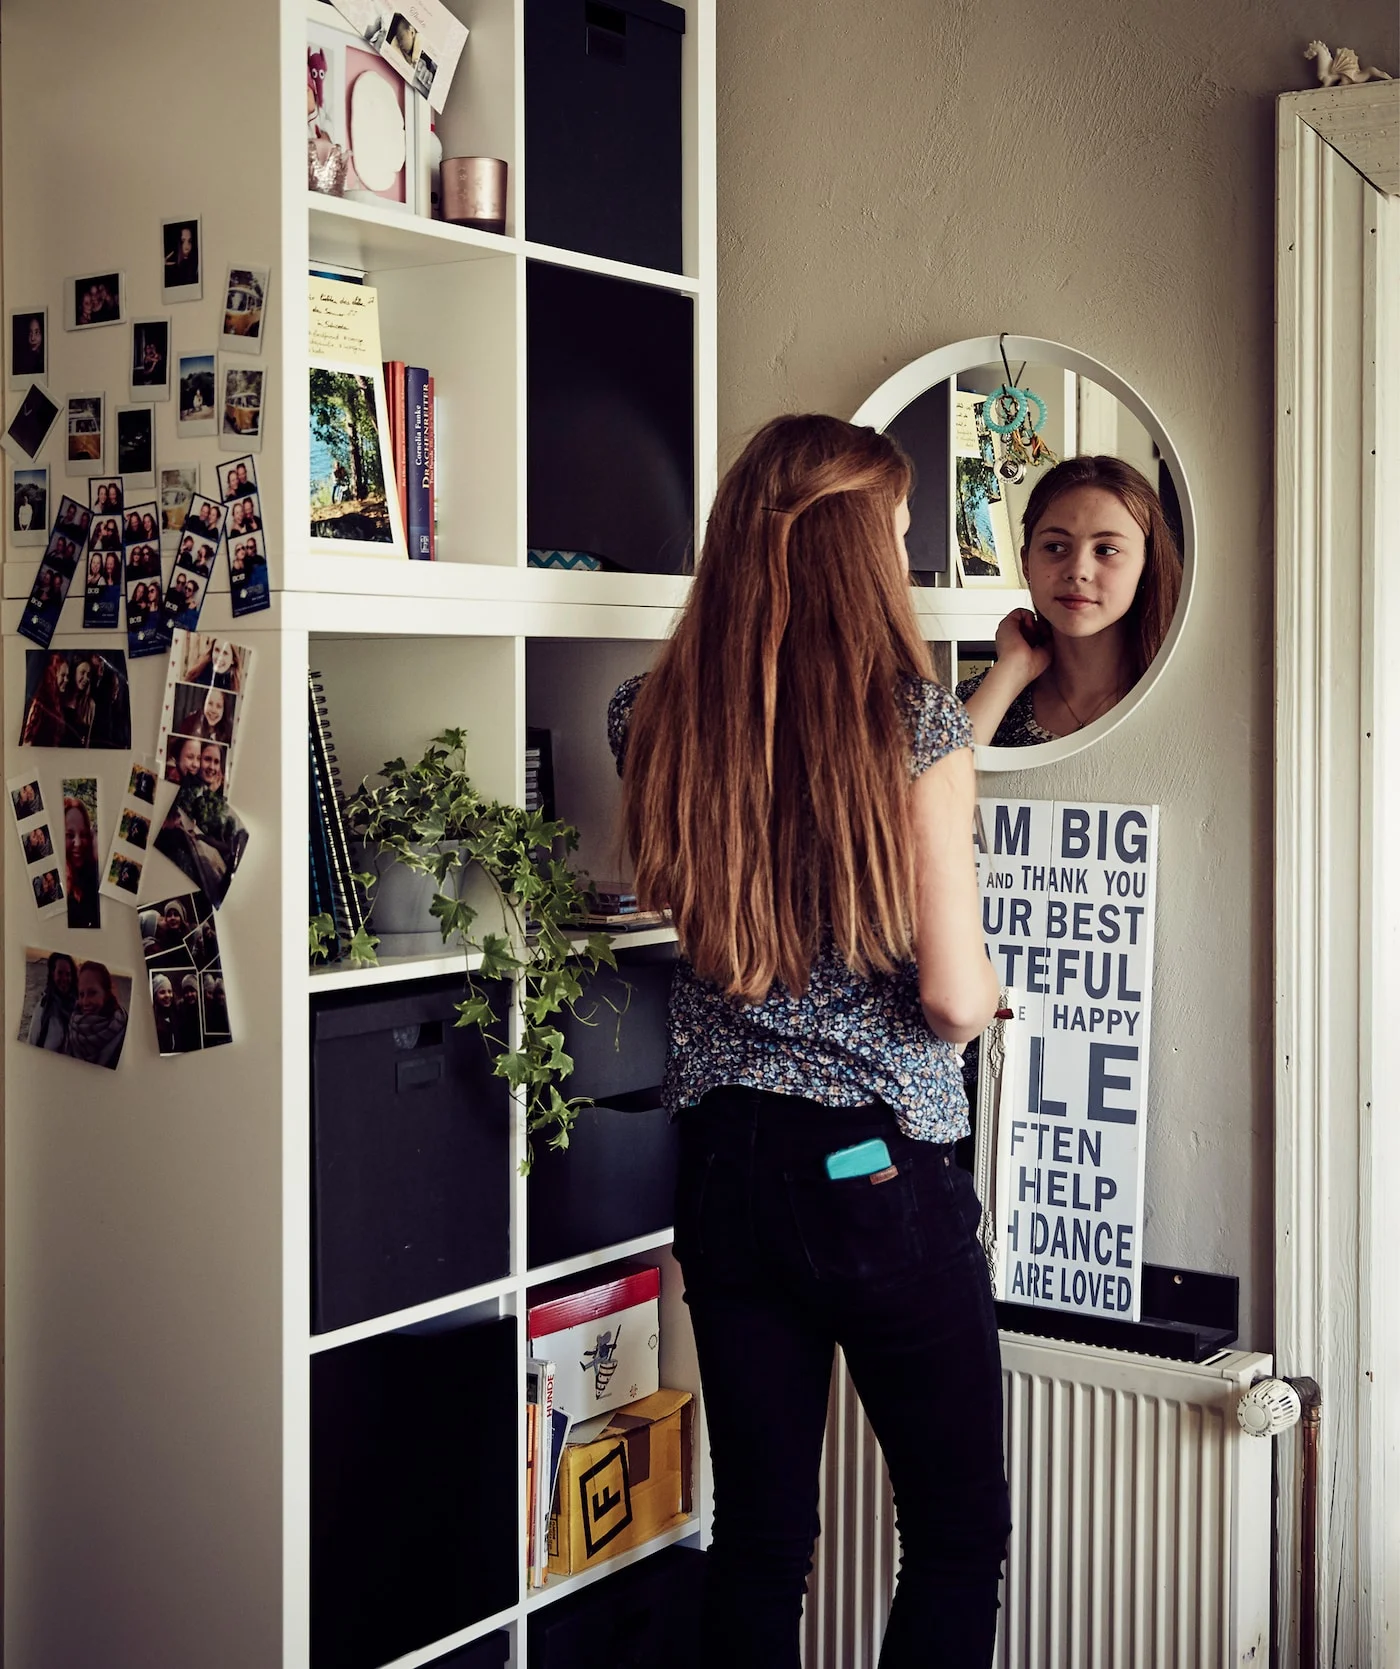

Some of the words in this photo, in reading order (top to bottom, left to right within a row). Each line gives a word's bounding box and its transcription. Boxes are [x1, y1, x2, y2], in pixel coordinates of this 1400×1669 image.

[414, 404, 422, 429] Funke
[422, 383, 430, 489] DRACHENREITER
[414, 431, 422, 466] Cornelia
[972, 804, 1031, 856] AM
[1061, 808, 1148, 864] BIG
[986, 872, 1013, 889] AND
[1021, 865, 1088, 894] THANK
[1103, 870, 1146, 898] YOU
[1047, 900, 1145, 945] BEST
[984, 943, 1141, 1002] TEFUL
[1053, 1004, 1140, 1036] HAPPY
[1018, 1166, 1118, 1213] HELP
[1030, 1212, 1133, 1269] DANCE
[1011, 1260, 1054, 1300] ARE
[1060, 1267, 1132, 1312] LOVED
[546, 1374, 555, 1418] HUNDE
[592, 1485, 621, 1523] F
